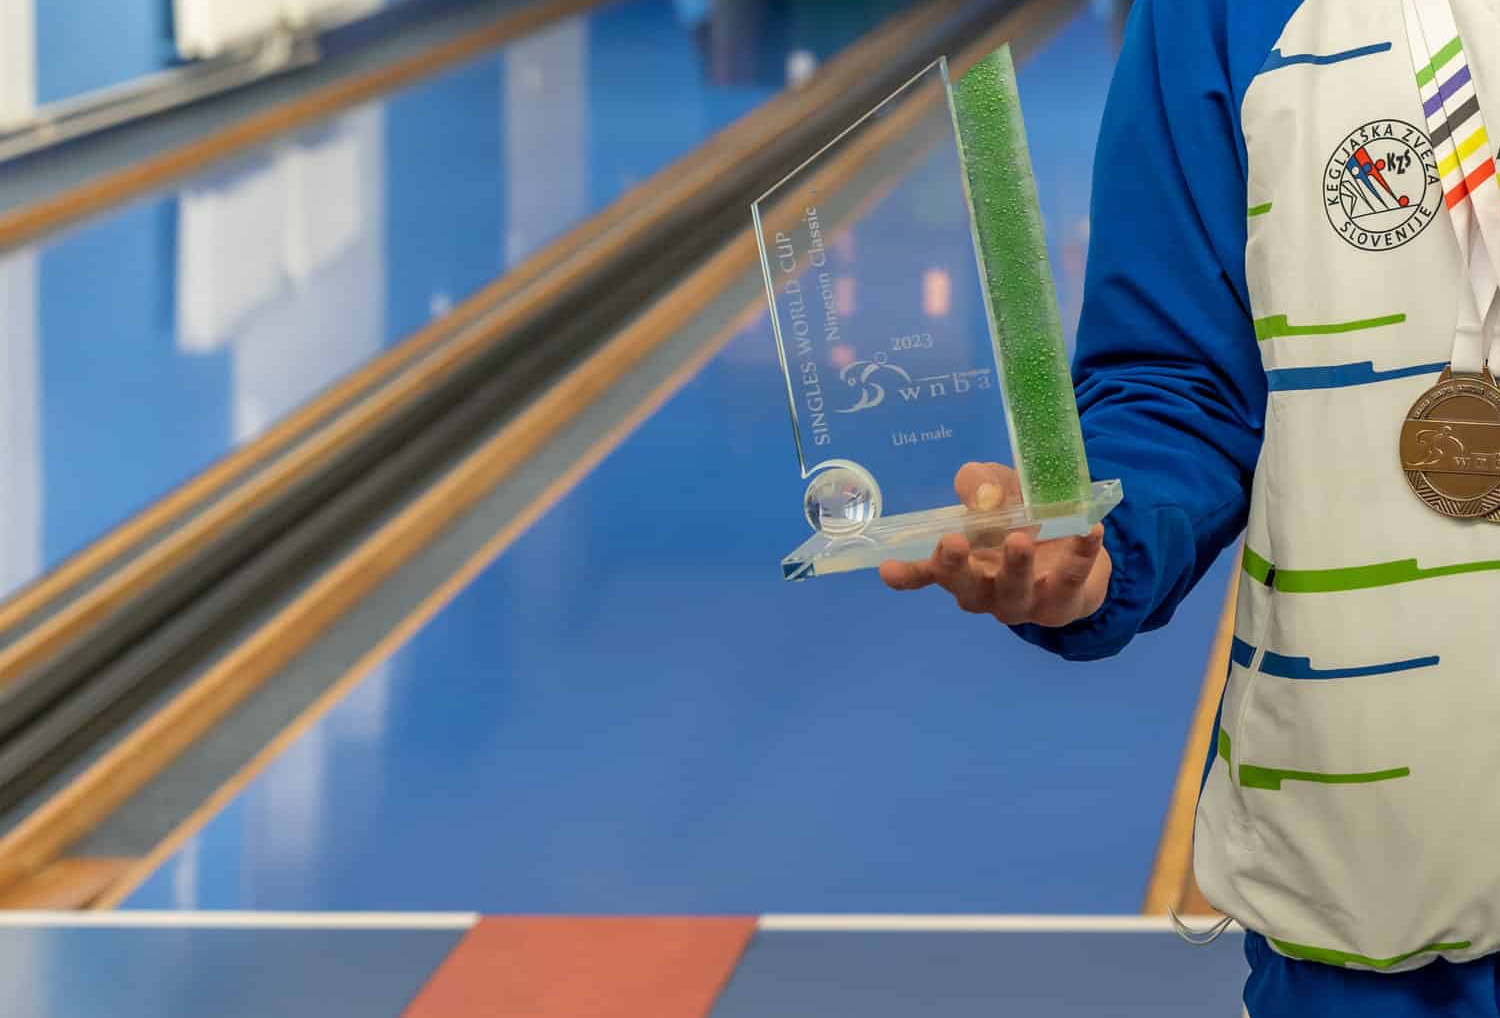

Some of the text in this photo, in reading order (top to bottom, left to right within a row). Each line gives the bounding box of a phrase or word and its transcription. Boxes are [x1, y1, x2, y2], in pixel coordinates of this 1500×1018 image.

[1402, 128, 1441, 186] ZVEZA
[1340, 205, 1432, 247] SLOVENIJE
[775, 231, 831, 446] SINGLES WORLD CUP
[889, 332, 934, 351] 2023
[898, 370, 992, 402] wnba
[920, 423, 953, 442] male
